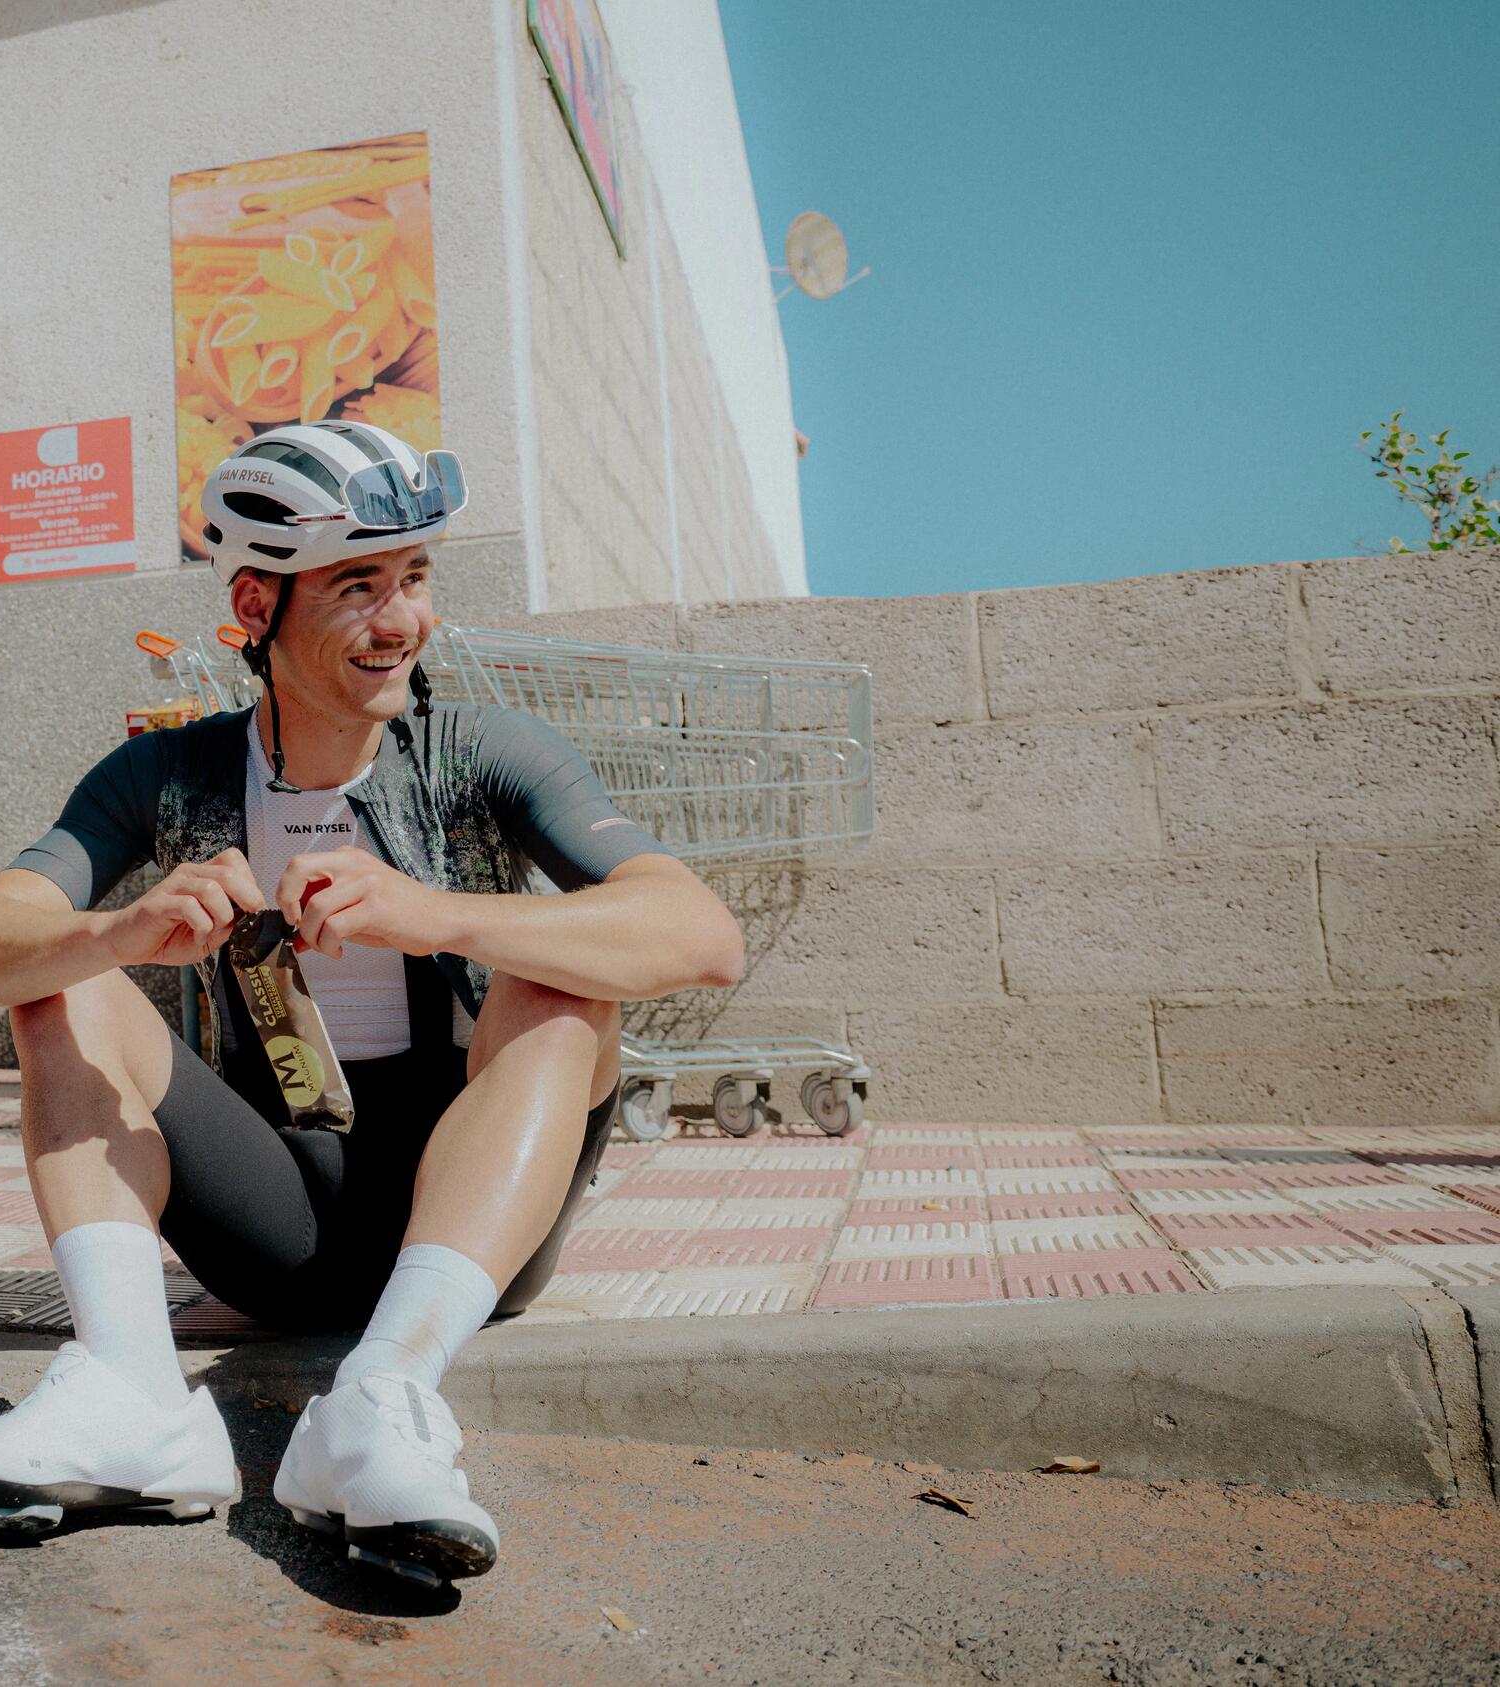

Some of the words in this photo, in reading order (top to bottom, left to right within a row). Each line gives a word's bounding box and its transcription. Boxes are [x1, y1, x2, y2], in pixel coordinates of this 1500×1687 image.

[11, 462, 105, 490] HORARIO
[219, 469, 238, 481] VAN
[238, 470, 275, 485] RYSEL
[38, 518, 79, 529] Verano
[284, 825, 312, 834] VAN
[315, 823, 352, 834] RYSEL
[271, 1051, 307, 1090] M
[293, 1044, 317, 1092] MAGNUM
